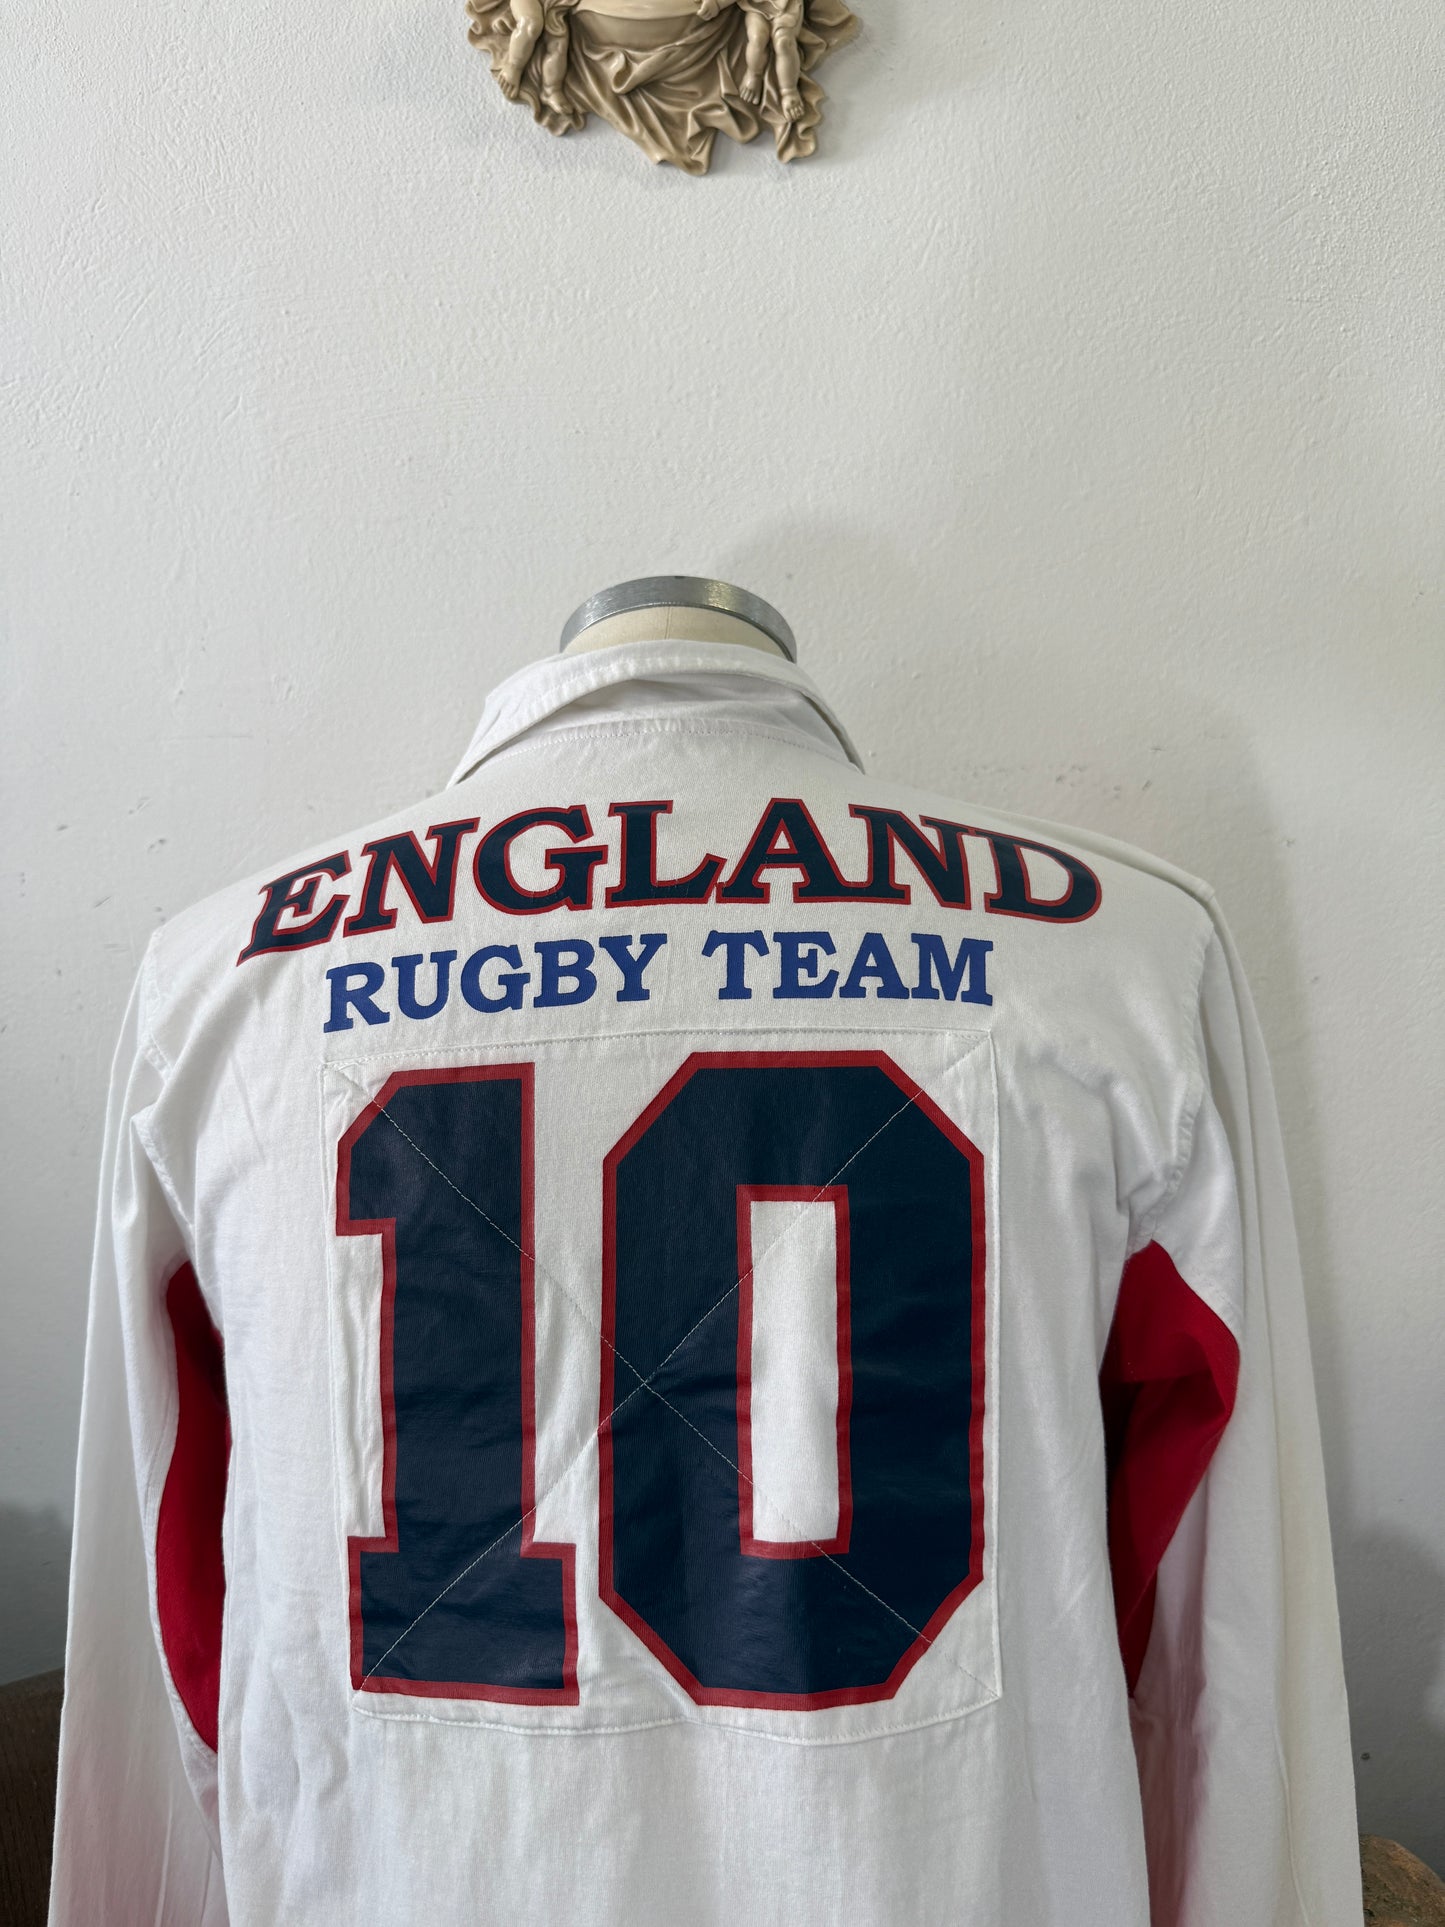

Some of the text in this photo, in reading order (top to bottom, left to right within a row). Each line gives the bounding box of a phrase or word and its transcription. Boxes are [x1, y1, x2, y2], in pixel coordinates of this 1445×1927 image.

[236, 797, 1103, 967] ENGLAND
[323, 928, 994, 1034] RUGBY TEAM
[335, 1049, 987, 1712] 10
